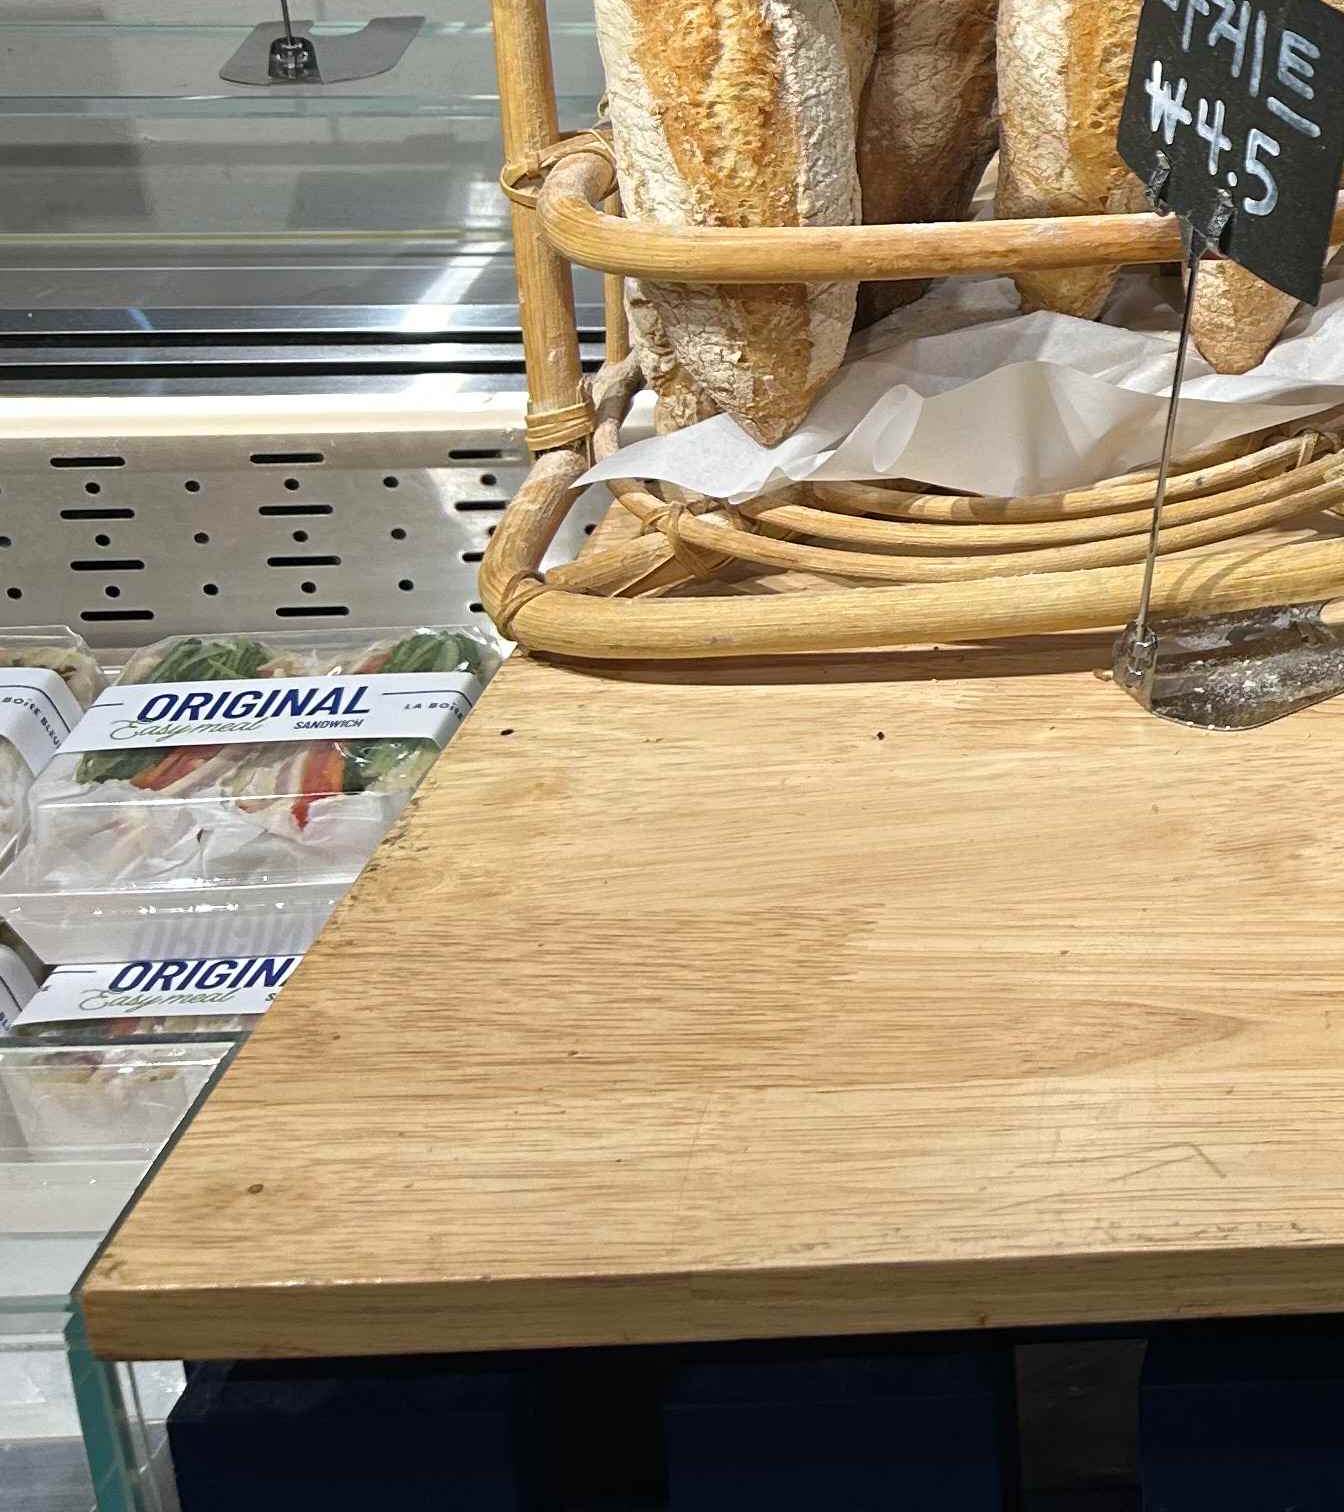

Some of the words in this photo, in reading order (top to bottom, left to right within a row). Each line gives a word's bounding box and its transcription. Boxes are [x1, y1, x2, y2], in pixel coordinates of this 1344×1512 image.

[137, 686, 370, 723] ORIGINAL
[294, 719, 364, 729] SANDWICH
[108, 958, 295, 992] ORIGIN
